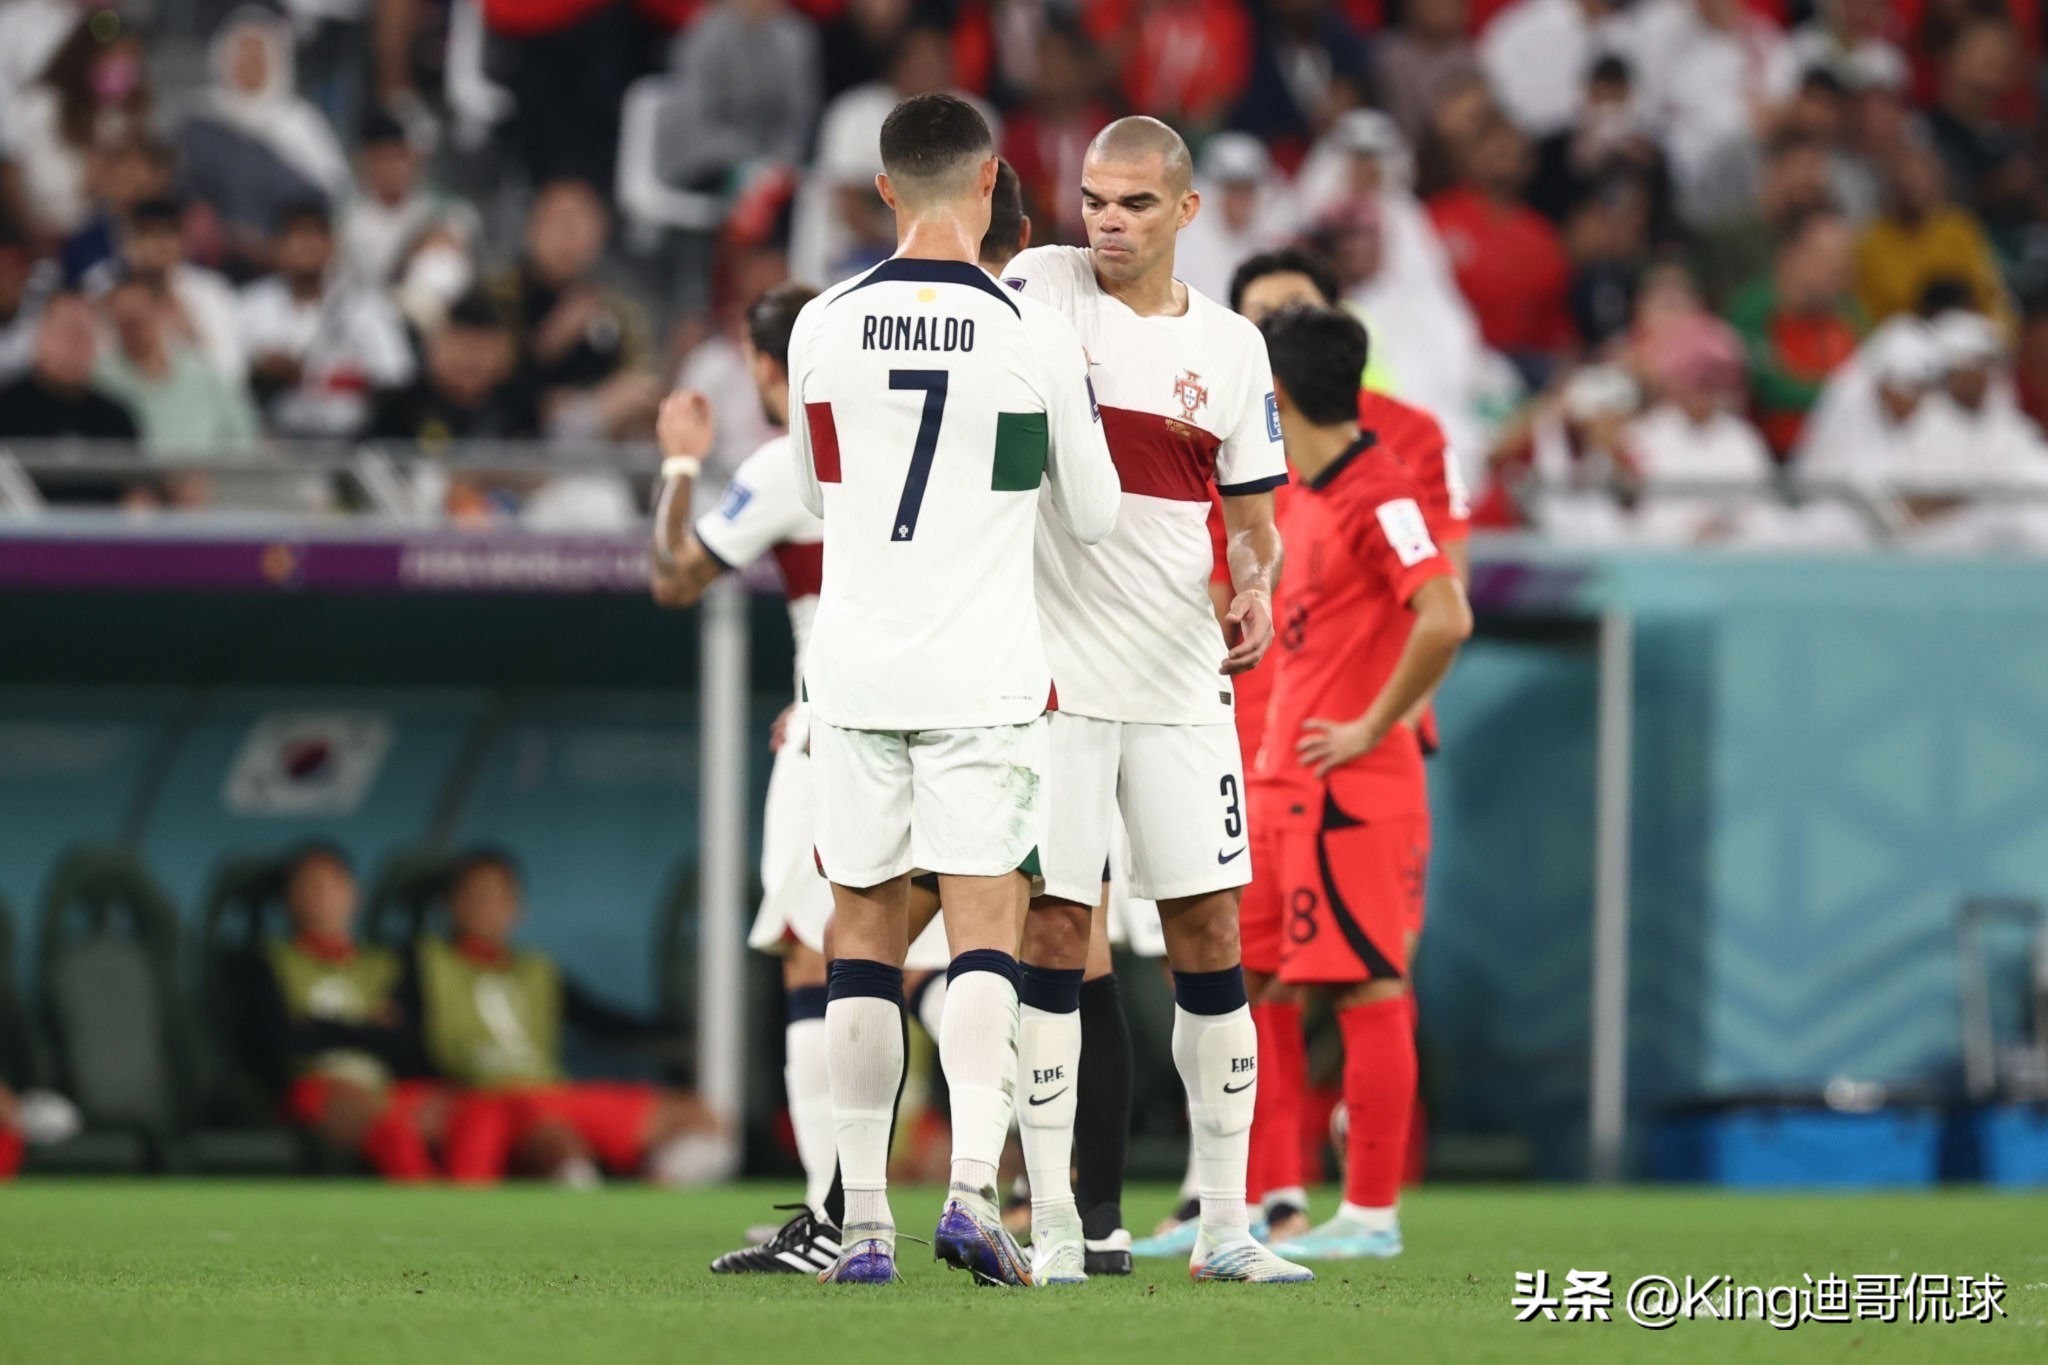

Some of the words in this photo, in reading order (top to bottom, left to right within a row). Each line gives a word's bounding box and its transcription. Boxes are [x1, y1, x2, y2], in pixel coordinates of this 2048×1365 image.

[862, 315, 975, 352] RONALDO
[889, 369, 949, 542] 7
[1220, 774, 1242, 838] 3
[1290, 887, 1318, 944] 8
